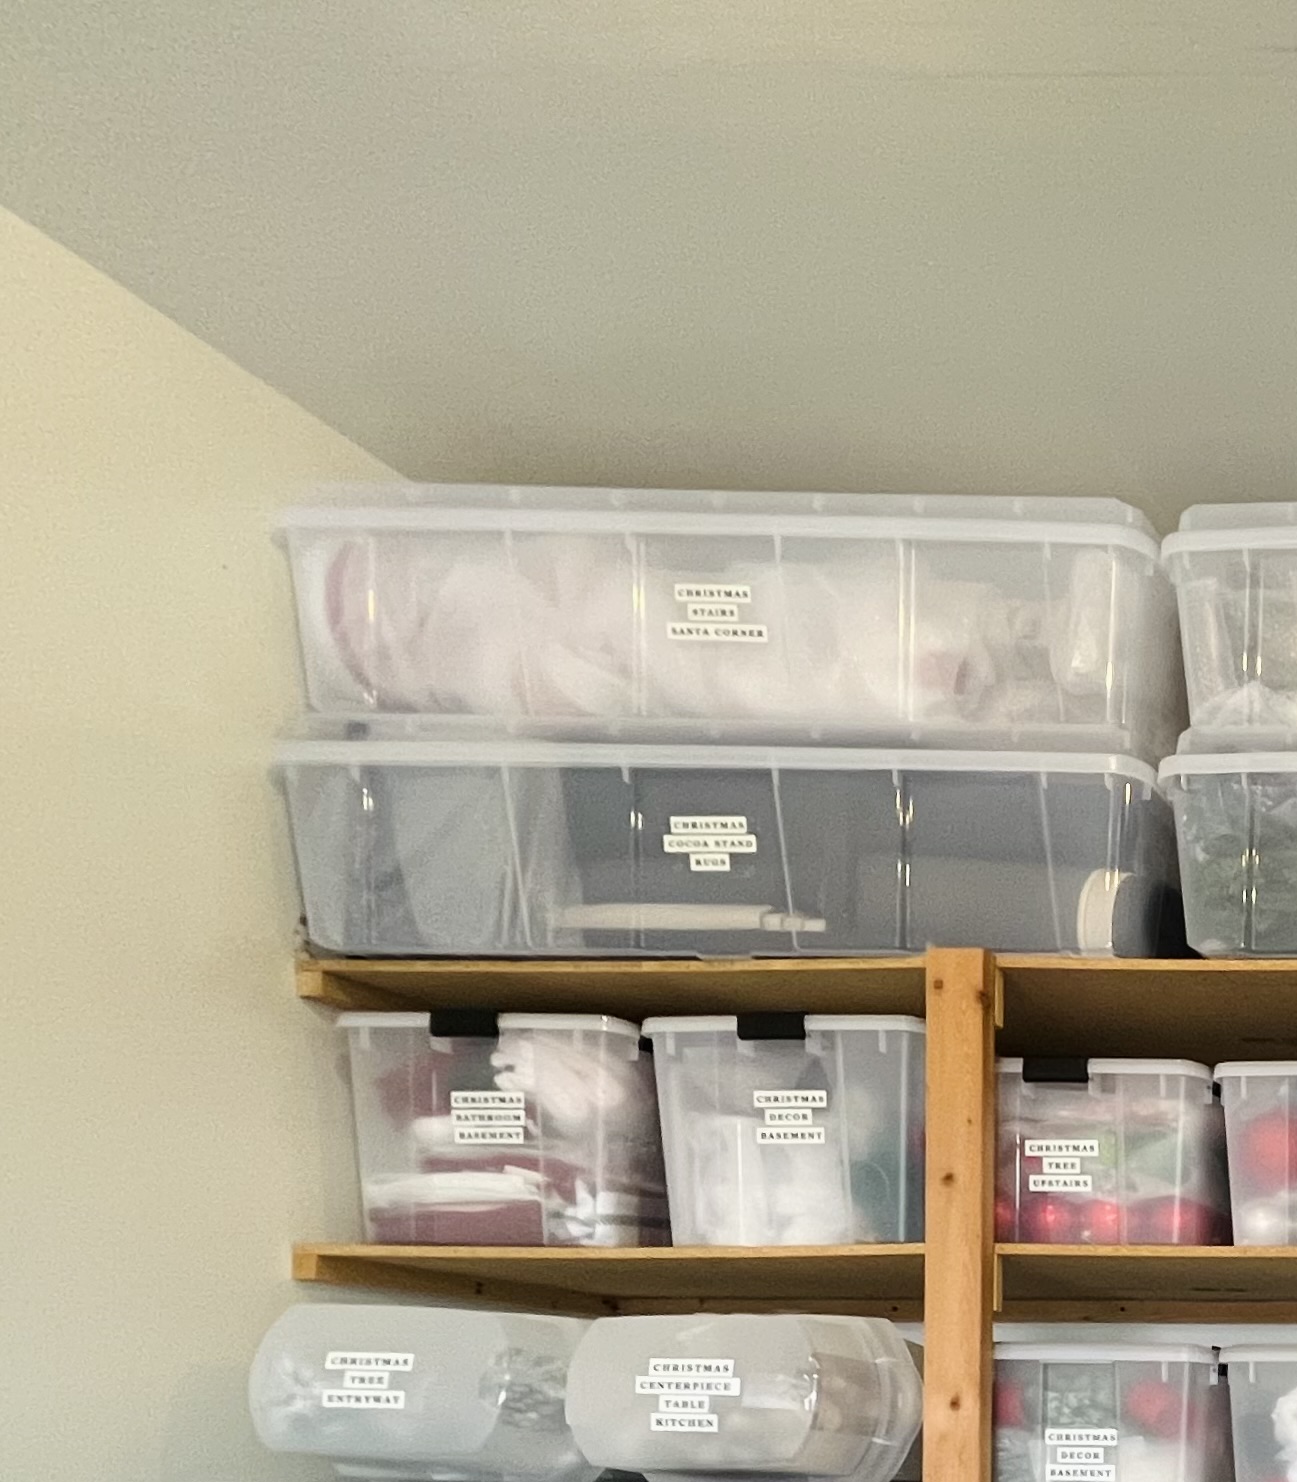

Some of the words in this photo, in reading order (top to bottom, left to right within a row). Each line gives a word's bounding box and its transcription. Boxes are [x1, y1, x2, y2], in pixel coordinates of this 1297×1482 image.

[677, 589, 749, 598] CHRISTMAS
[714, 629, 764, 637] CORNER
[673, 821, 746, 830] CHRISTMAS
[667, 839, 710, 848] COCOA
[714, 840, 753, 848] STAND
[695, 858, 727, 867] RUGS
[756, 1095, 824, 1103] CHRISTMAS
[769, 1113, 809, 1121] DECOR
[760, 1132, 822, 1140] BASEMENT
[1028, 1144, 1095, 1153] CHRISTMAS
[1048, 1161, 1076, 1170] TREE
[1032, 1179, 1089, 1187] UPSTAIRS
[652, 1363, 730, 1373] CHRISTMAS
[639, 1381, 730, 1391] CENTERPIECE
[664, 1400, 705, 1409] TABLE
[655, 1418, 714, 1428] KITCHEN
[1047, 1433, 1117, 1442] CHRISTMAS
[1060, 1451, 1100, 1460] DECOR
[1050, 1469, 1112, 1477] BASEMENT
